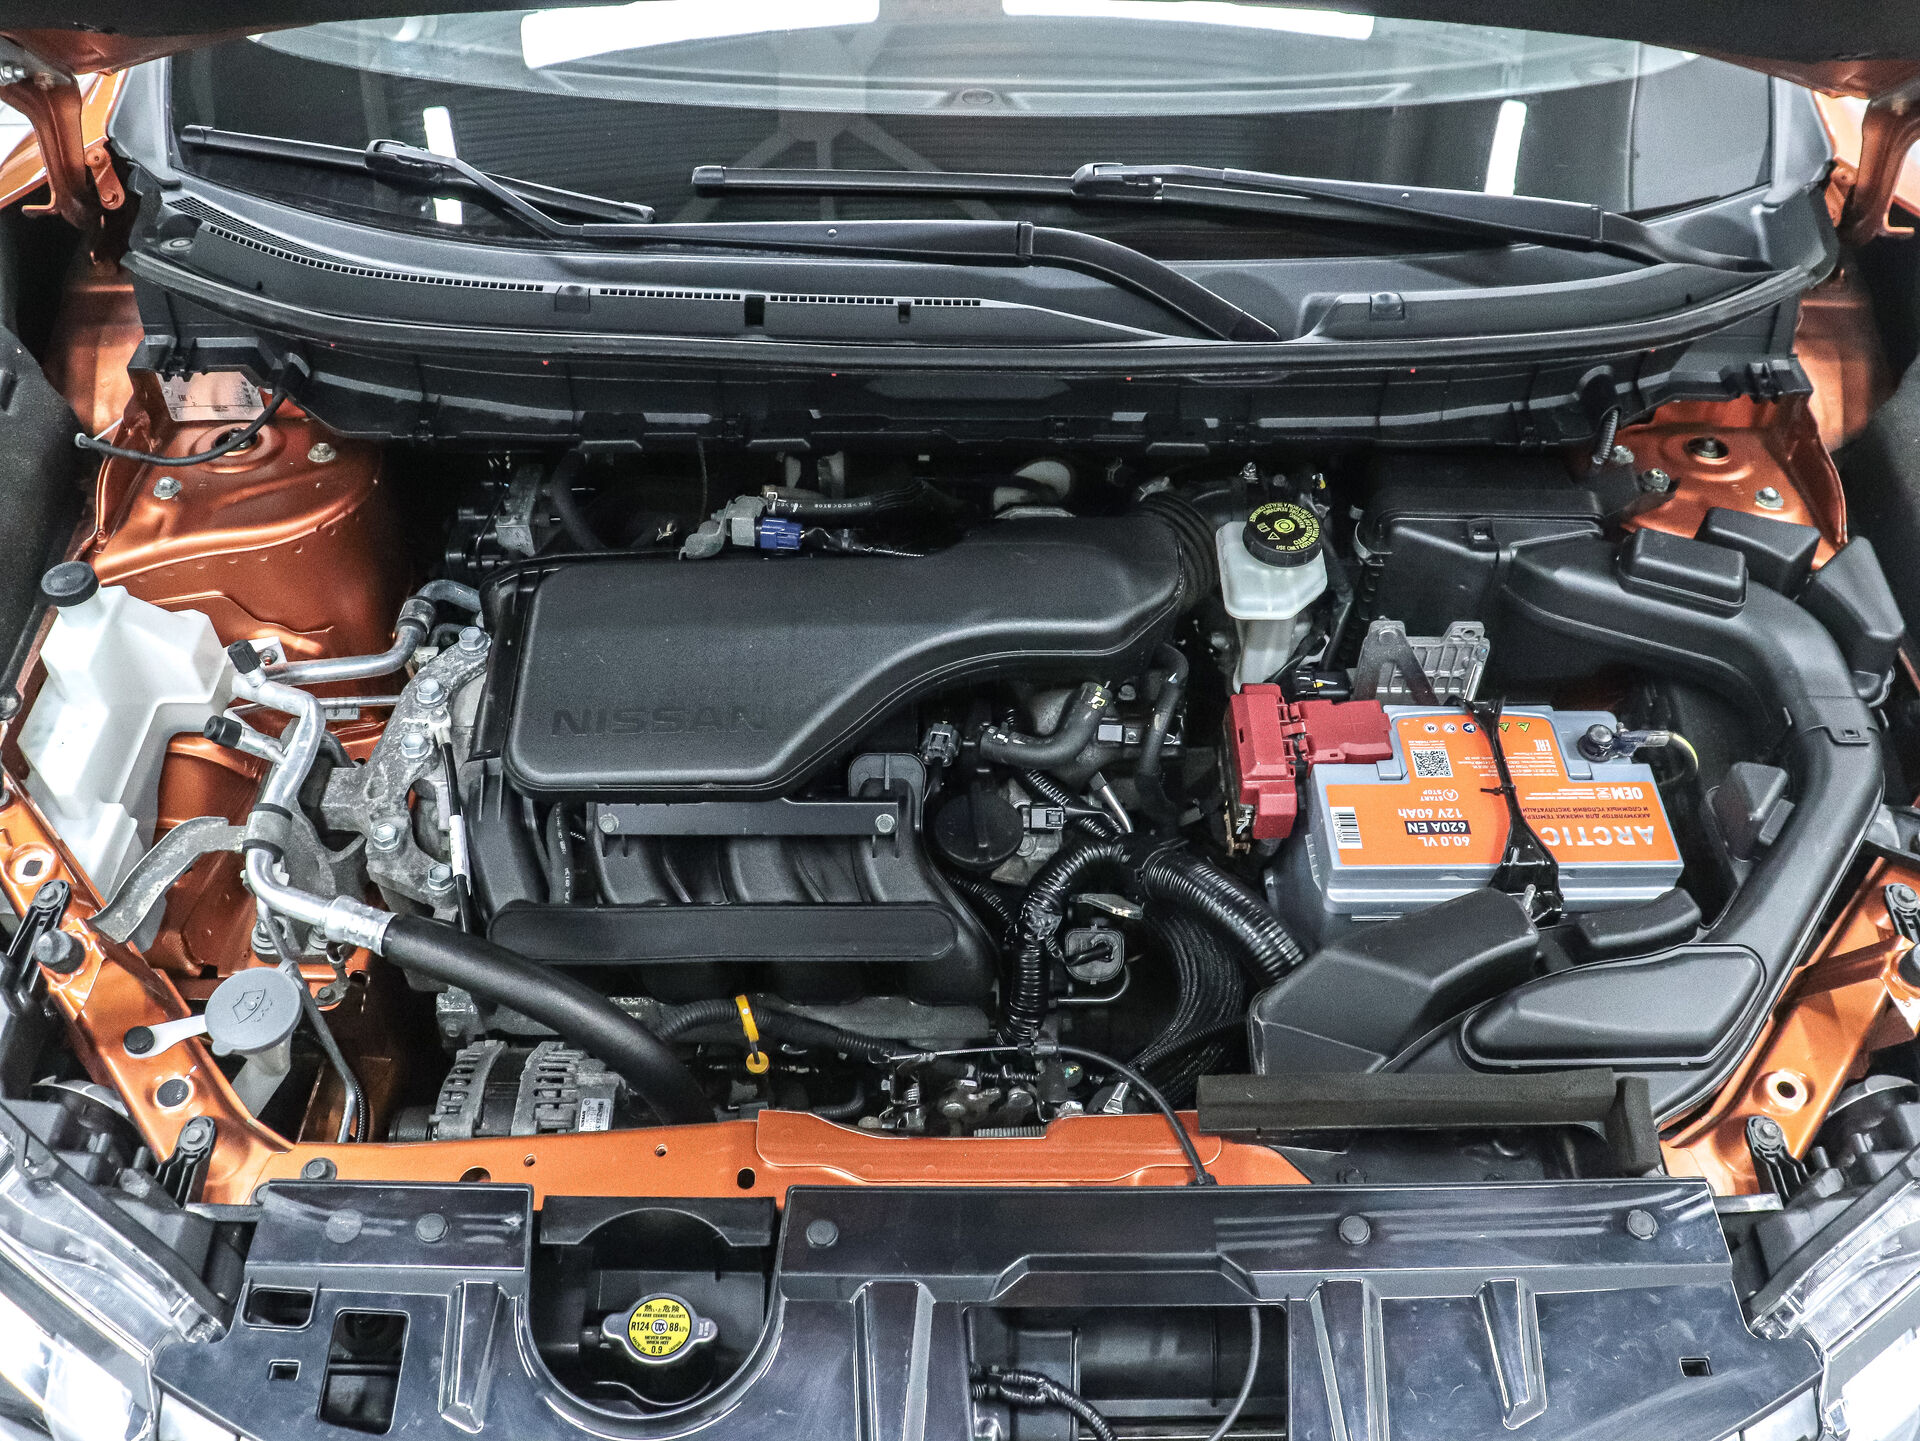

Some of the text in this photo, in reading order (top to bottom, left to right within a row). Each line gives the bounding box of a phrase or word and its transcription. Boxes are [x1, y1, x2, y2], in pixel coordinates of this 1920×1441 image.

[551, 708, 767, 737] NISSAN
[1610, 787, 1643, 800] OEM
[1398, 808, 1463, 818] 12V 60Ah
[1406, 822, 1466, 833] 620A EN
[1418, 836, 1470, 846] 60.0 VL
[1540, 826, 1654, 846] ARCTIC
[630, 1322, 650, 1331] R124
[669, 1322, 679, 1332] 88
[651, 1346, 662, 1354] 0.9
